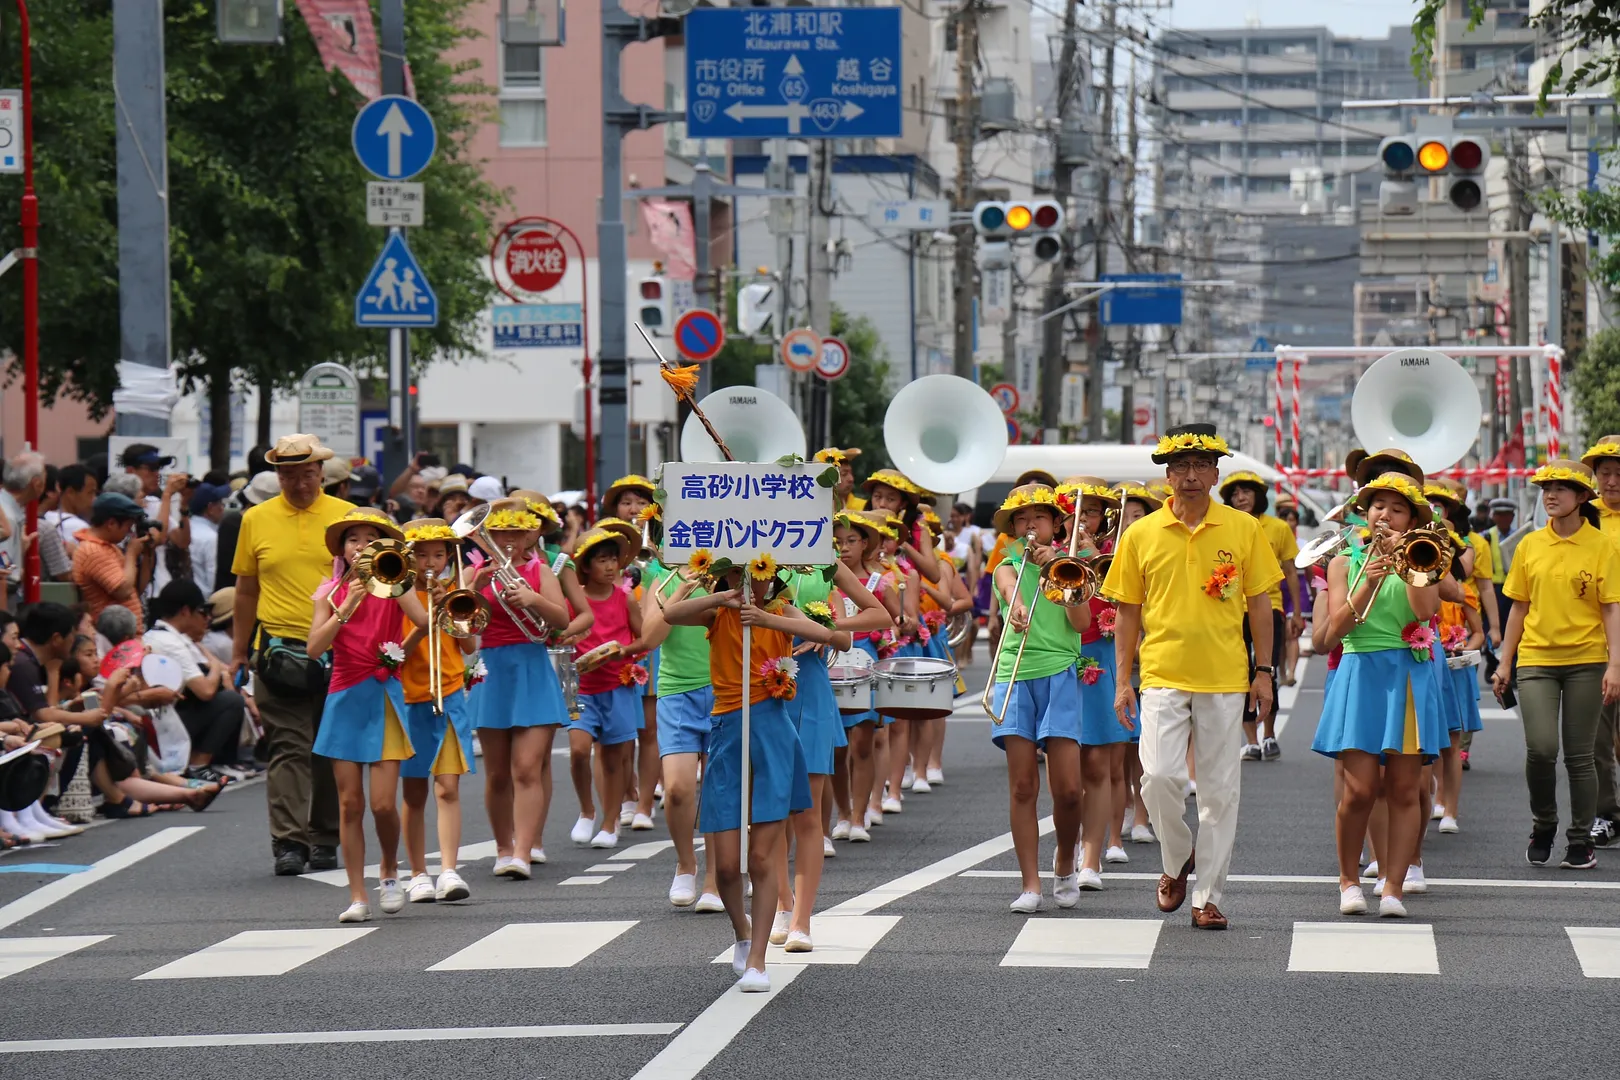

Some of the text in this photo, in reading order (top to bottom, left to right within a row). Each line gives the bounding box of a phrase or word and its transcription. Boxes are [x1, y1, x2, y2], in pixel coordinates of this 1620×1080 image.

[744, 12, 843, 35] 北浦和駅
[746, 38, 840, 50] Kitaurawa Sta.
[695, 58, 765, 81] 市役所
[696, 83, 765, 98] City Office
[784, 81, 802, 96] 65
[831, 83, 896, 98] Koshigaya
[698, 104, 711, 117] 17
[814, 104, 840, 118] 463
[509, 248, 563, 274] 消火栓
[1399, 357, 1430, 366] YAMAHA
[728, 395, 757, 405] YAMAHA
[681, 473, 815, 500] 高砂小学校
[668, 516, 829, 549] 金管バンドクラブ
